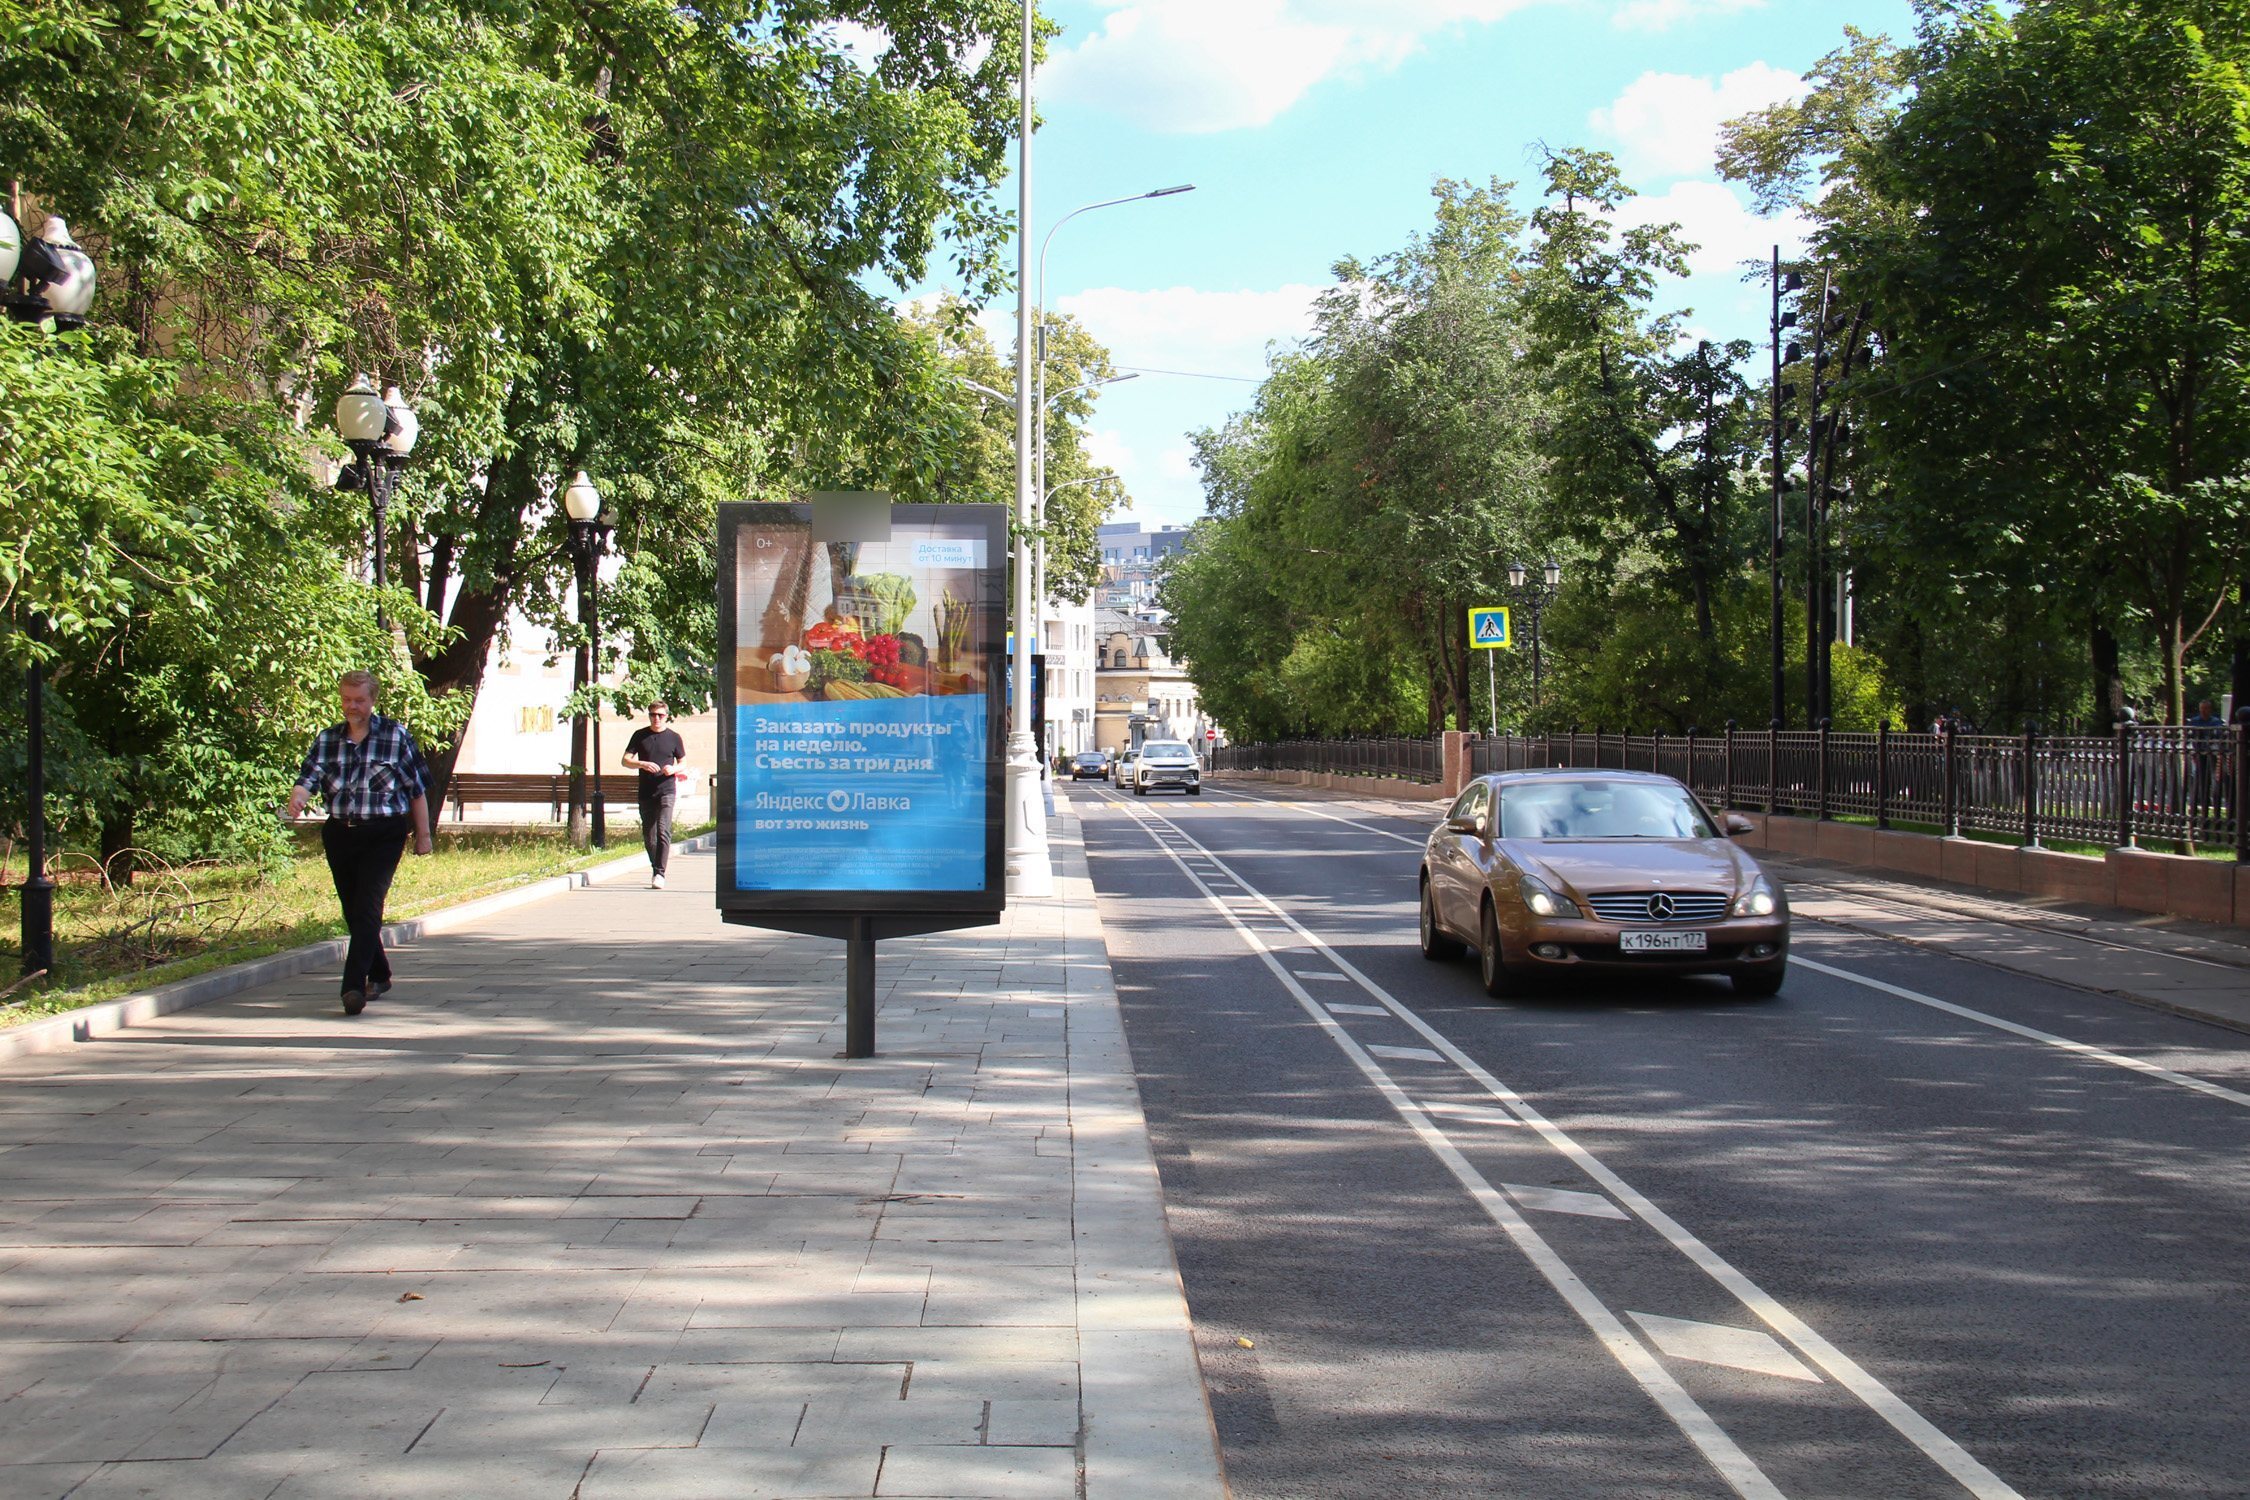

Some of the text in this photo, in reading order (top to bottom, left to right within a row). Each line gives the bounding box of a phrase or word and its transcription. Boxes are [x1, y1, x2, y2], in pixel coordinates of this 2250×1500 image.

[756, 538, 773, 549] 0+
[918, 544, 962, 554] Доставка
[931, 554, 942, 562] 10
[943, 555, 973, 564] минут
[755, 717, 952, 738] Заказать продукты
[755, 738, 867, 754] на неделю.
[755, 753, 933, 773] Съесть за три дня
[755, 792, 911, 811] Яндекс Лавка
[755, 818, 869, 830] вот это жизнь
